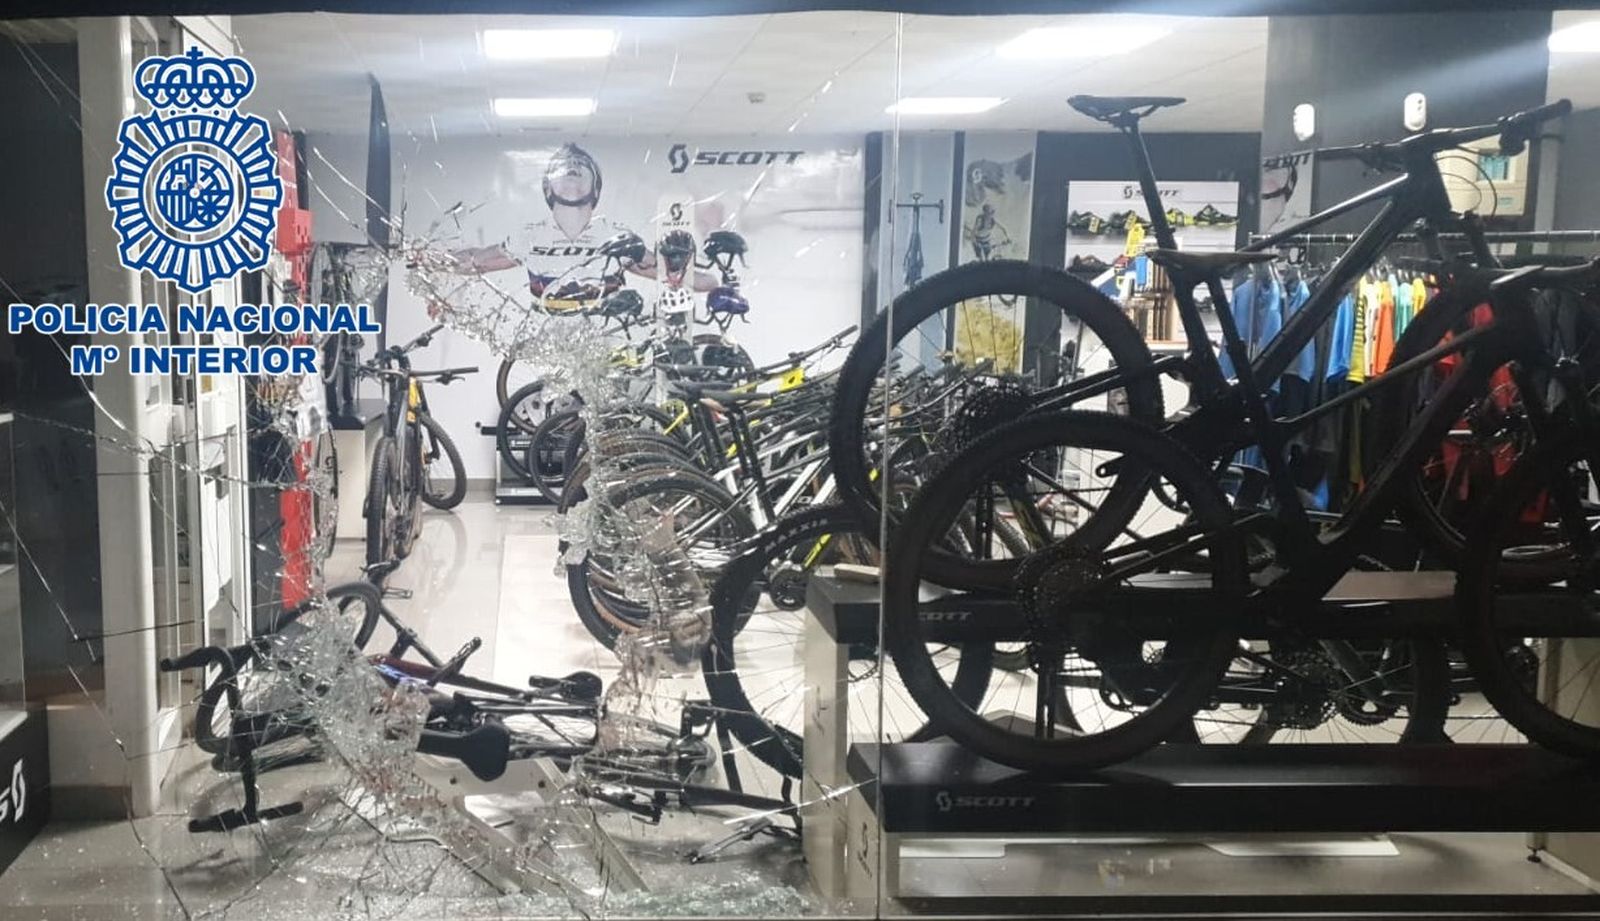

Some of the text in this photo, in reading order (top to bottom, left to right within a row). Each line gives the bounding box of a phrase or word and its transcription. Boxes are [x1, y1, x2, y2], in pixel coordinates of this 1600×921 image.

[694, 151, 805, 165] SCOTT
[529, 246, 602, 256] SCOT
[918, 611, 972, 620] COTT
[955, 796, 1035, 807] SCOTT
